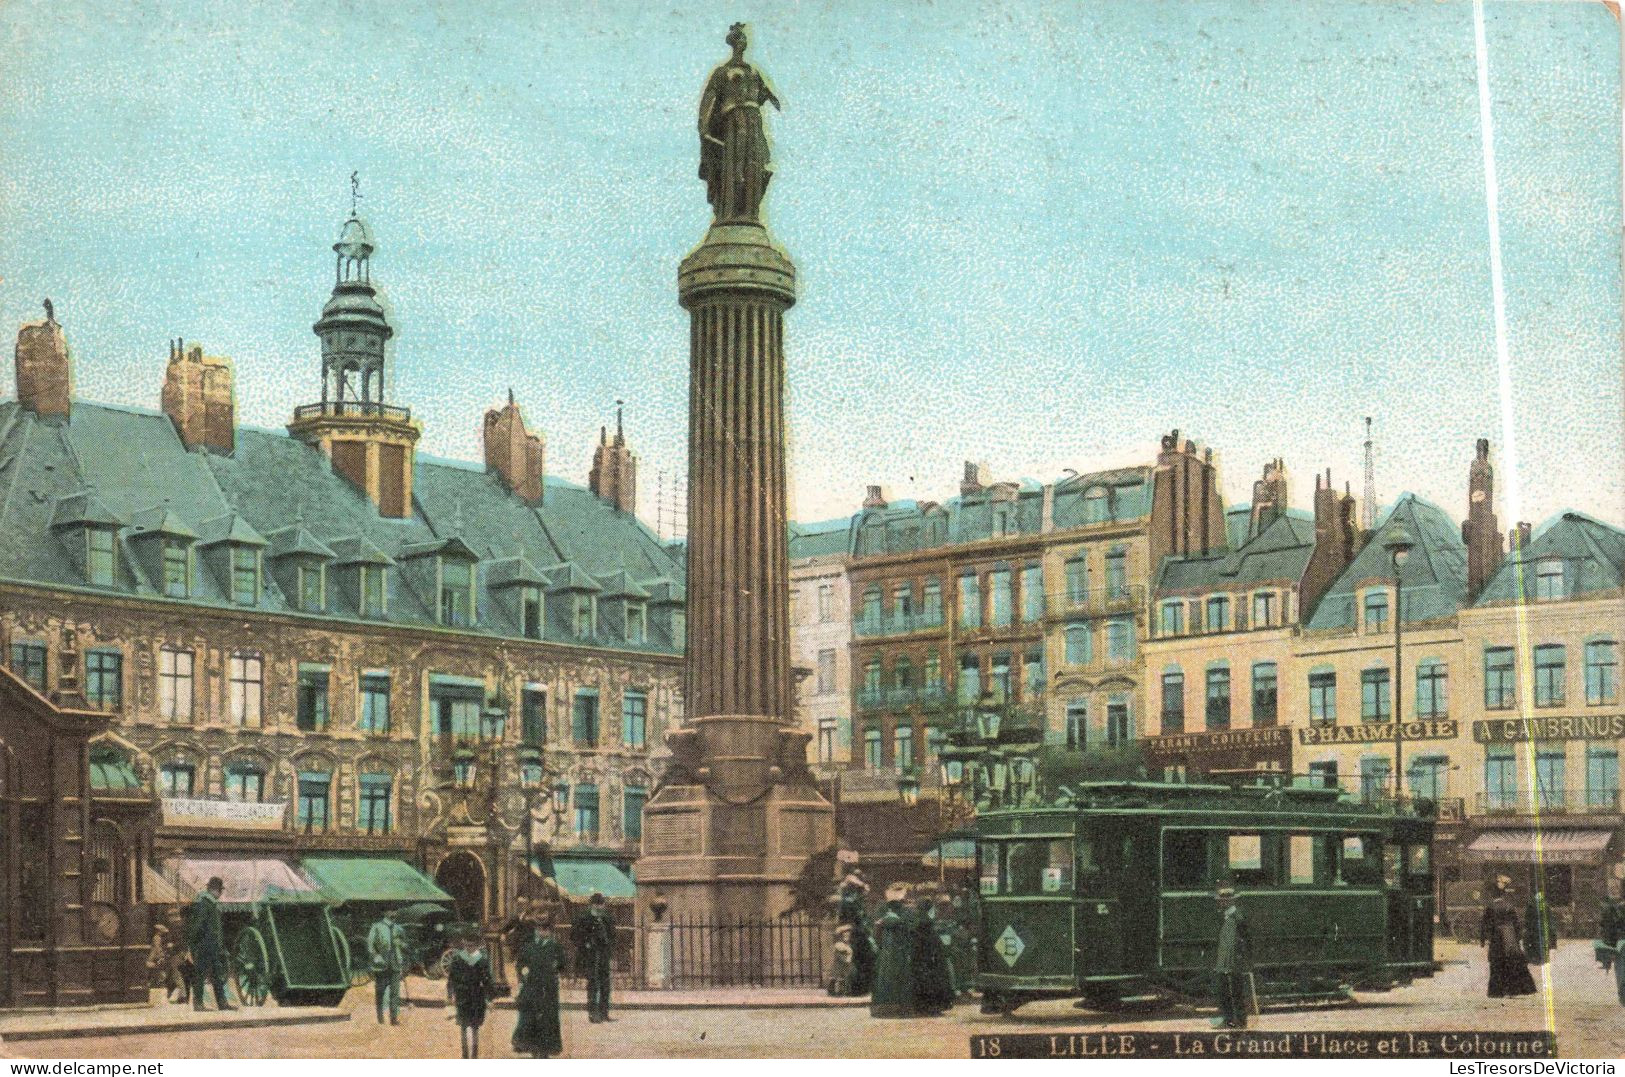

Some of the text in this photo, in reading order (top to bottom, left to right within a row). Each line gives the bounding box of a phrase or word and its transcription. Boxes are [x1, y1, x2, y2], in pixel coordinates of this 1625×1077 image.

[1211, 730, 1281, 745] COIFFEUR
[1302, 720, 1455, 743] PHARMACIE
[1481, 721, 1492, 740] A
[1004, 937, 1018, 956] B
